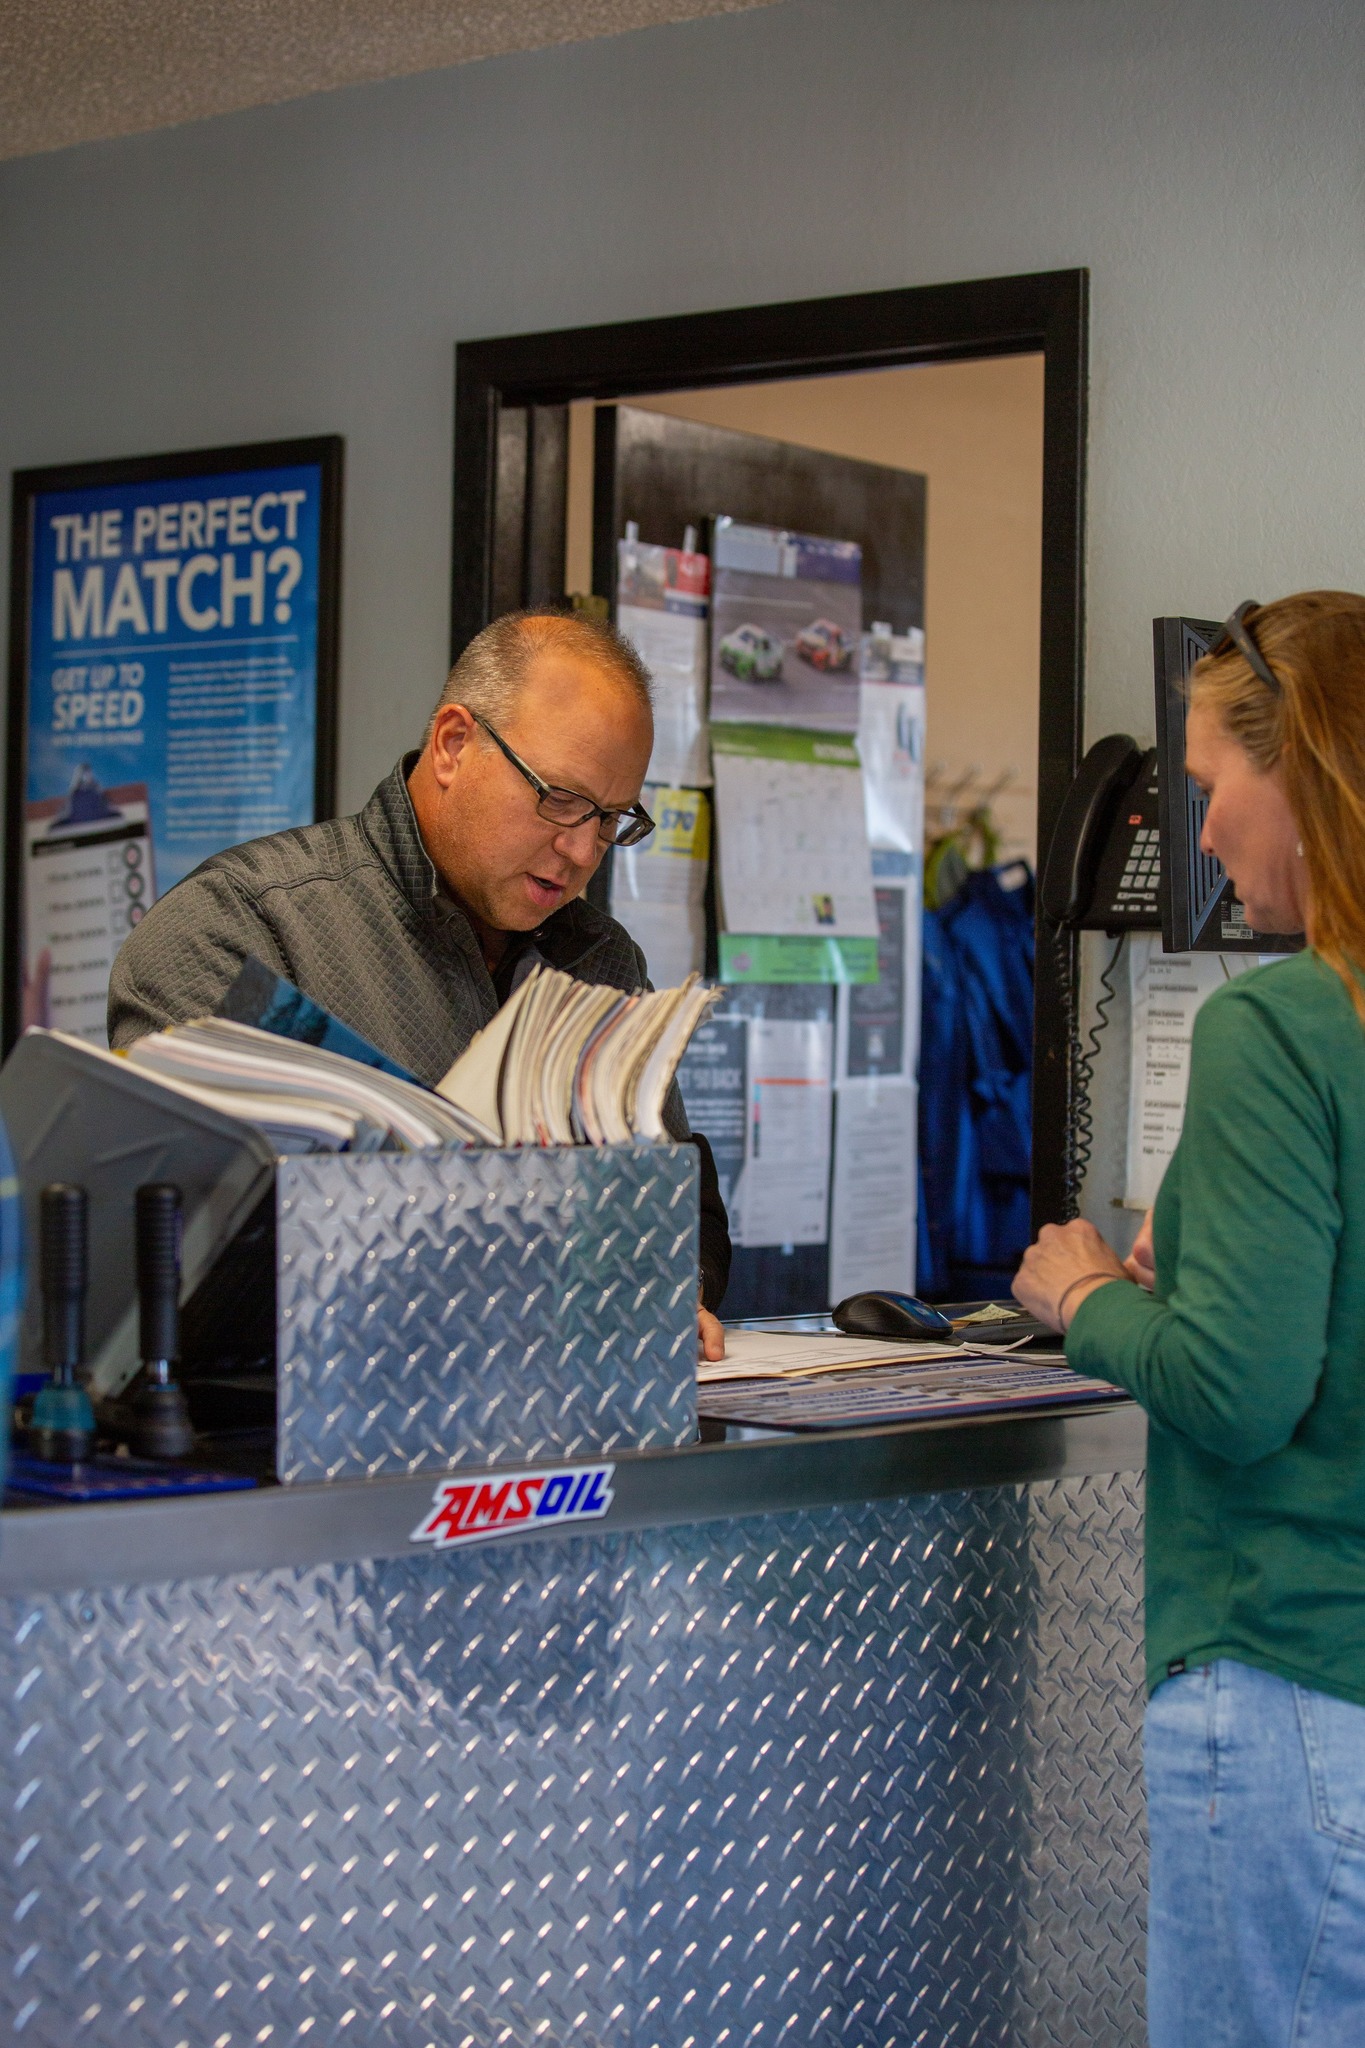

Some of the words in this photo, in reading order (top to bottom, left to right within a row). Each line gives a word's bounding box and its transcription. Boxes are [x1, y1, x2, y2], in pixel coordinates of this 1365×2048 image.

[51, 509, 122, 562] THE
[134, 490, 306, 555] PERFECT
[52, 546, 303, 641] MATCH?
[51, 666, 87, 692] GET
[89, 664, 116, 689] UP
[119, 662, 145, 687] TO
[52, 690, 145, 730] SPEED
[424, 1470, 608, 1539] AMSOIL
